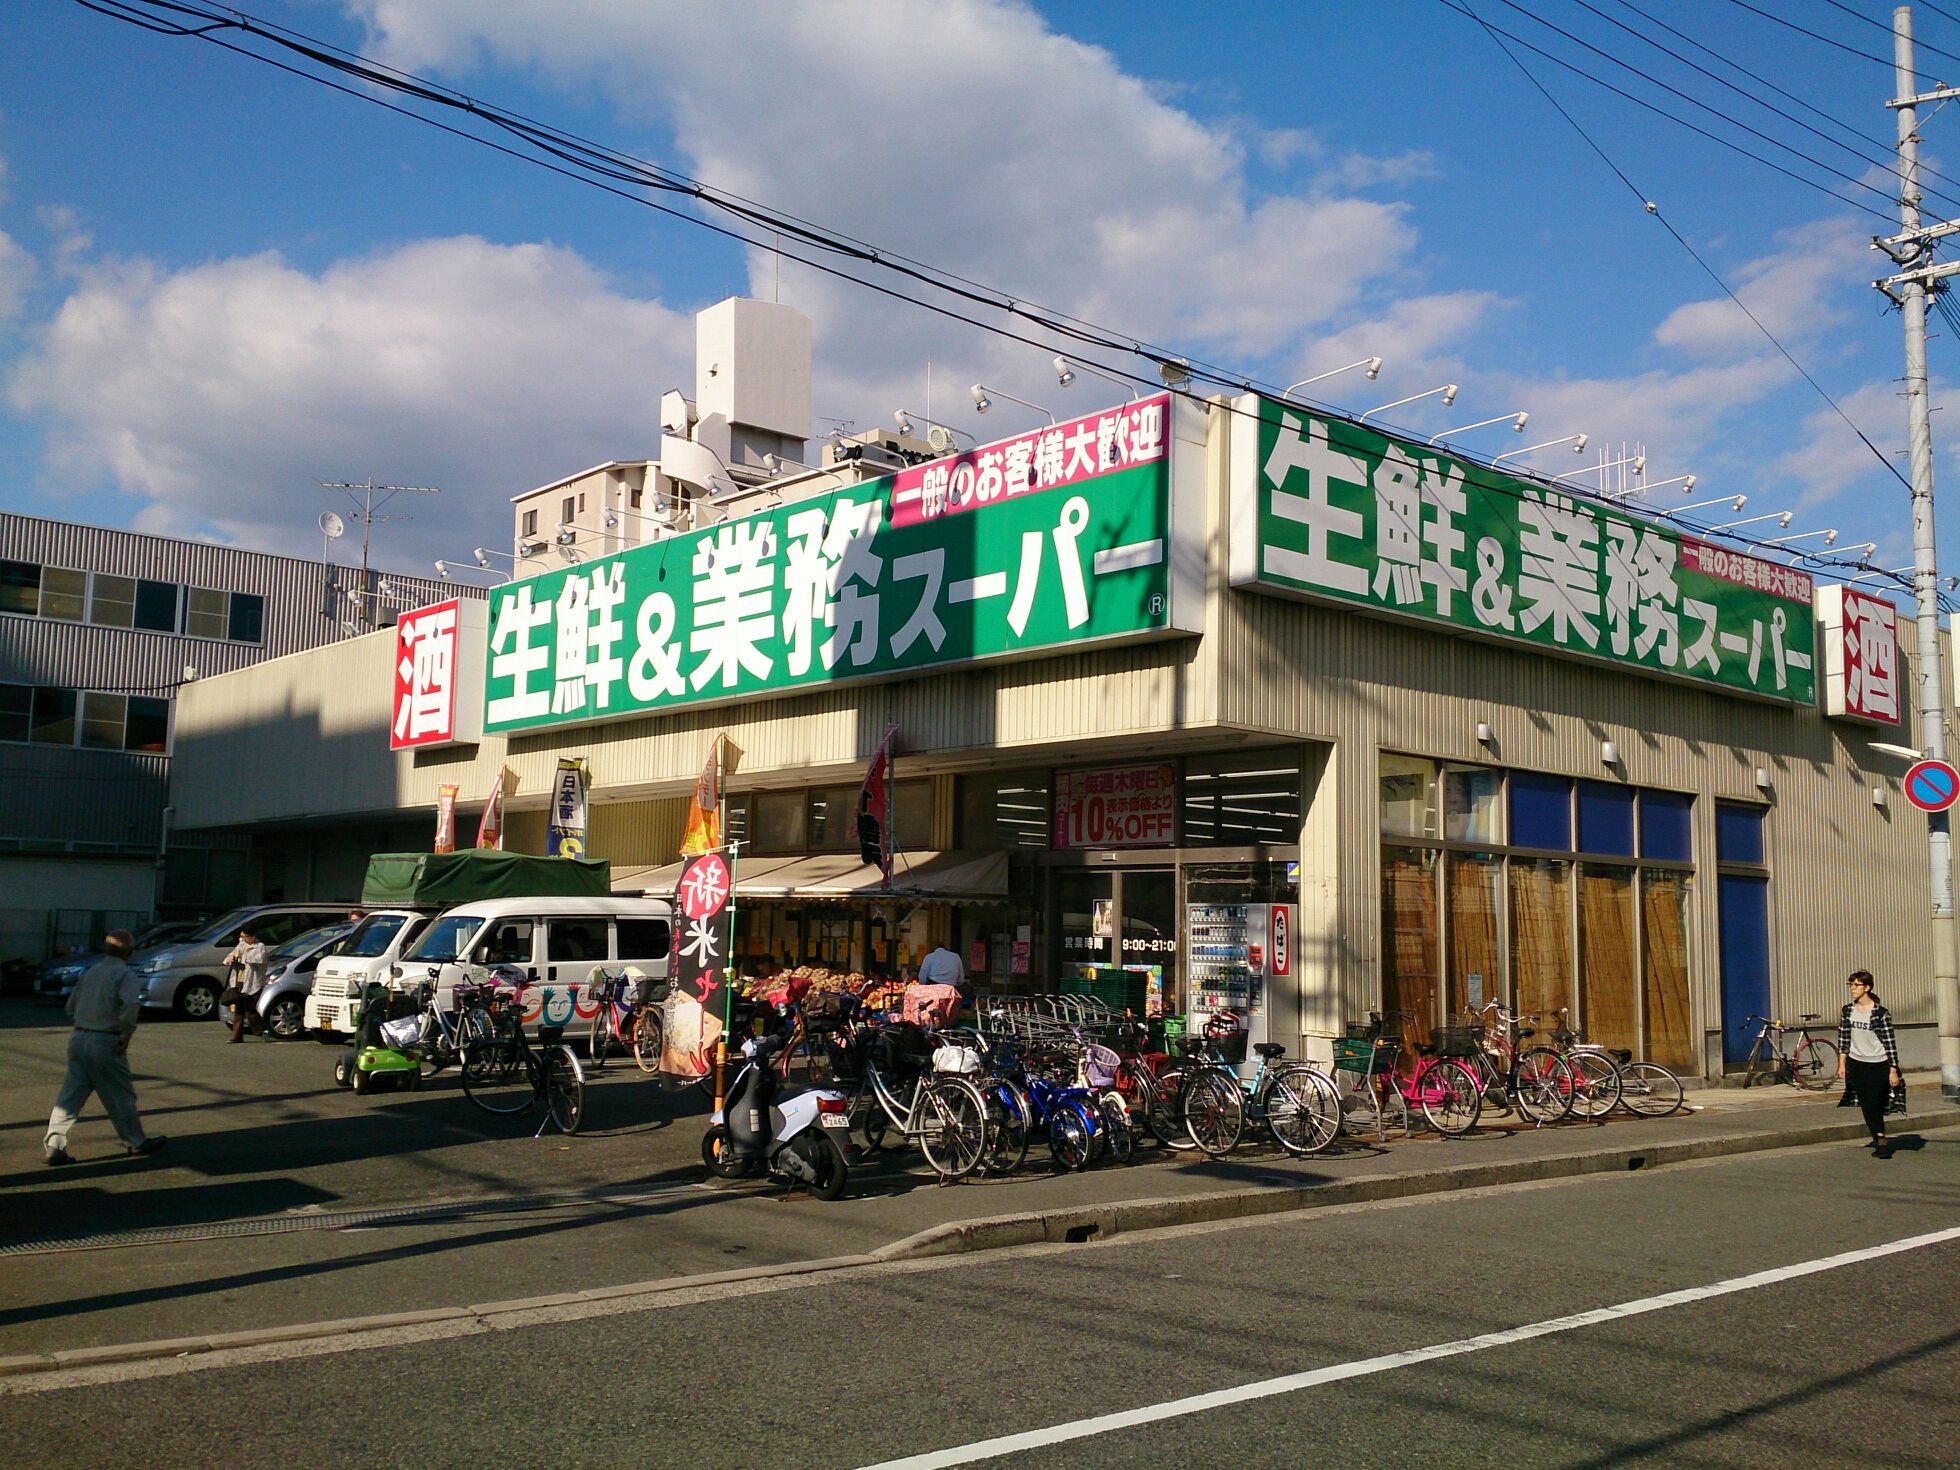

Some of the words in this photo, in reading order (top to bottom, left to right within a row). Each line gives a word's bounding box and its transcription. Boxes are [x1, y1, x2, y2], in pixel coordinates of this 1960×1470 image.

[896, 404, 1163, 519] 一般のお客様大歓迎
[1683, 545, 1812, 604] 一般のお客様大歓迎
[394, 608, 456, 740] 酒
[1844, 593, 1898, 720] 酒
[1086, 770, 1159, 794] 毎週木曜日
[1106, 794, 1172, 812] 表示価格より
[1065, 936, 1103, 950] 営業時間
[1276, 916, 1286, 964] たばこ
